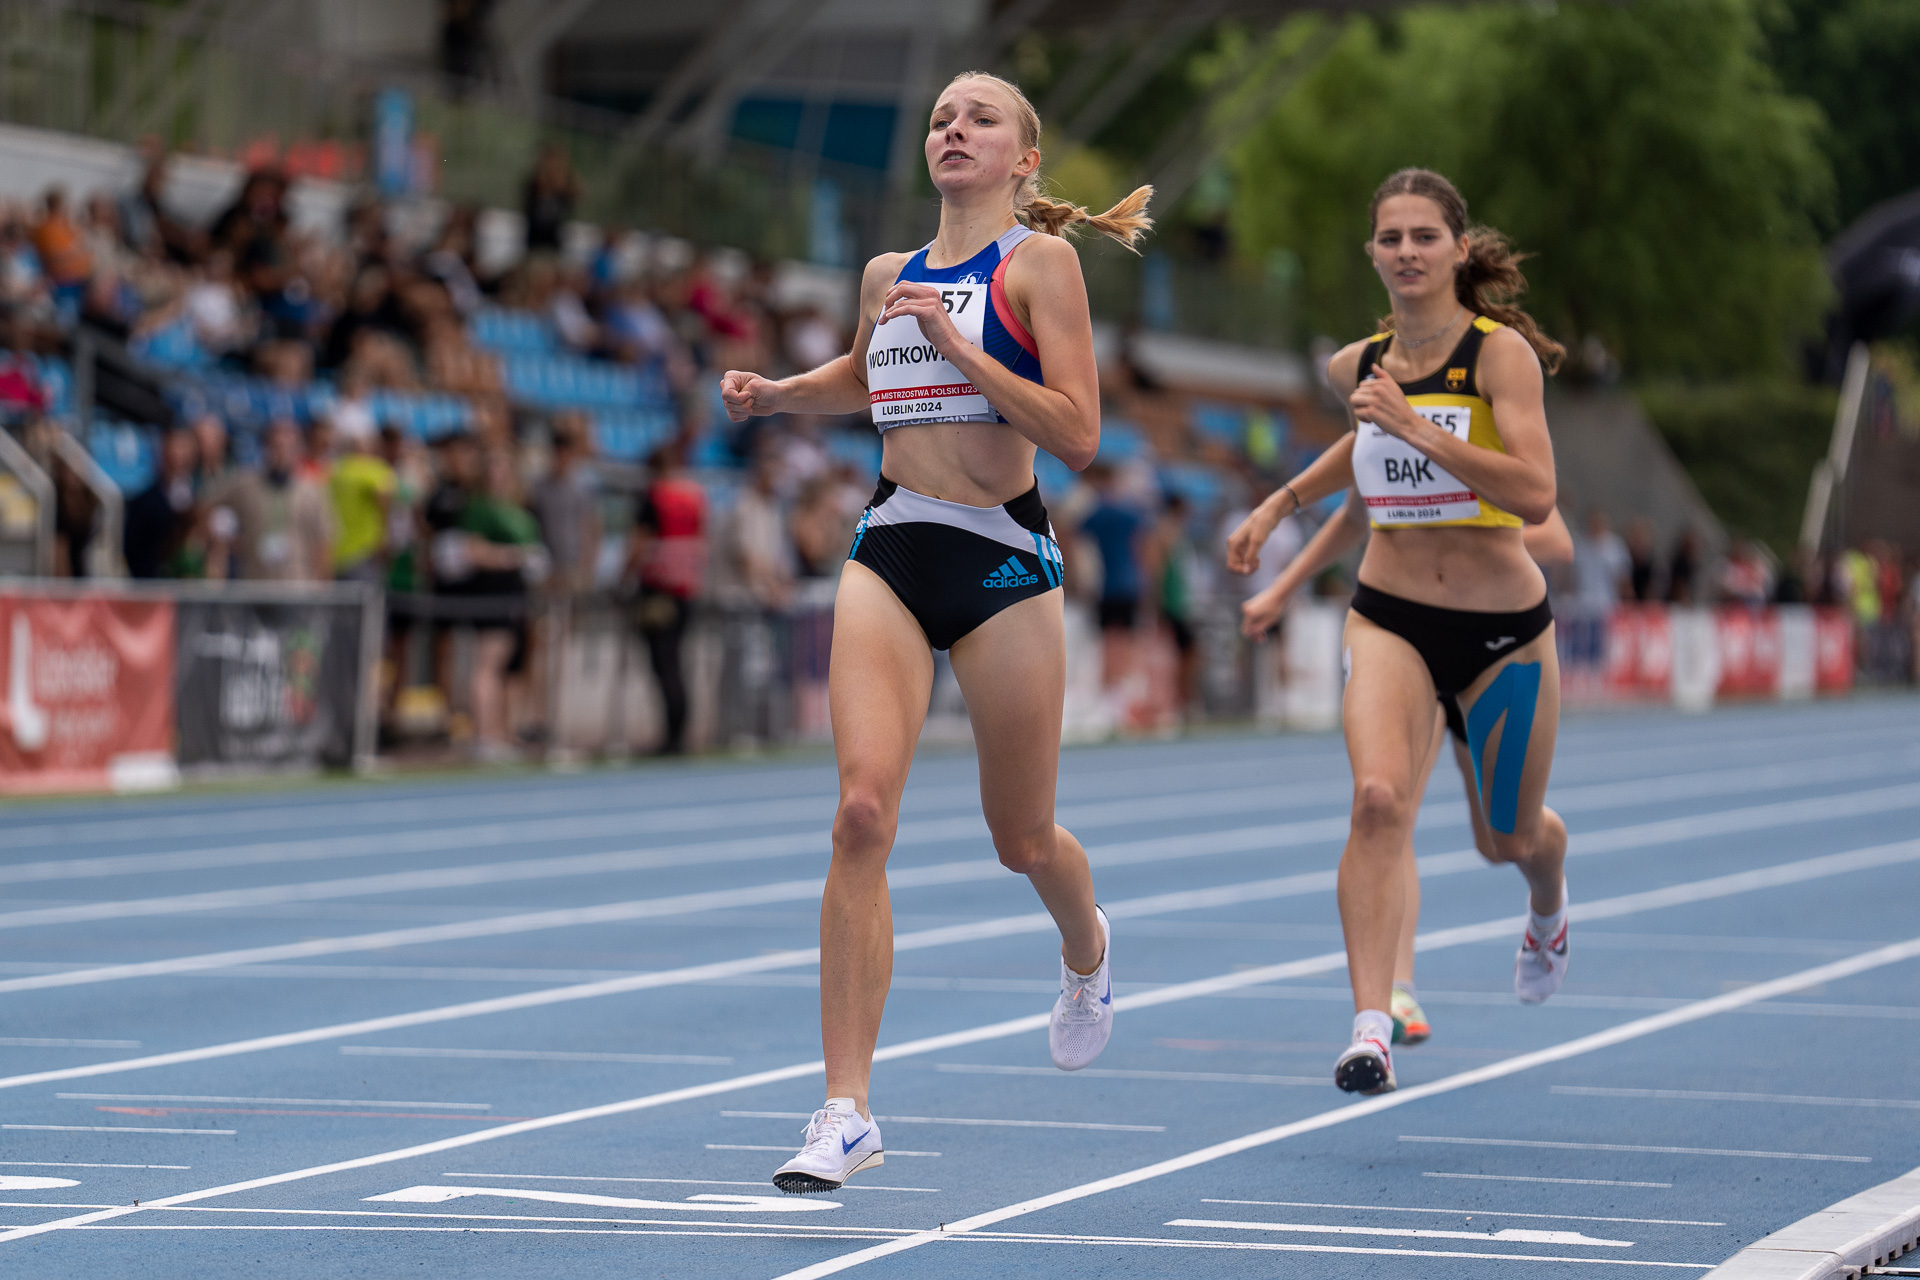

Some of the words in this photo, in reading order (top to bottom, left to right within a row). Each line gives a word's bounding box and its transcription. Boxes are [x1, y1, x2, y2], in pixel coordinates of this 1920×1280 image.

[869, 344, 946, 370] WOJTKOW
[881, 388, 930, 400] MISTRZOSTWA
[931, 385, 960, 396] POLSKI
[882, 403, 914, 416] LUBLIN
[915, 401, 943, 413] 2024
[1384, 456, 1435, 489] BĄK
[1387, 508, 1416, 519] LUBLIN
[1417, 507, 1442, 519] 2024
[982, 573, 1039, 589] adidas
